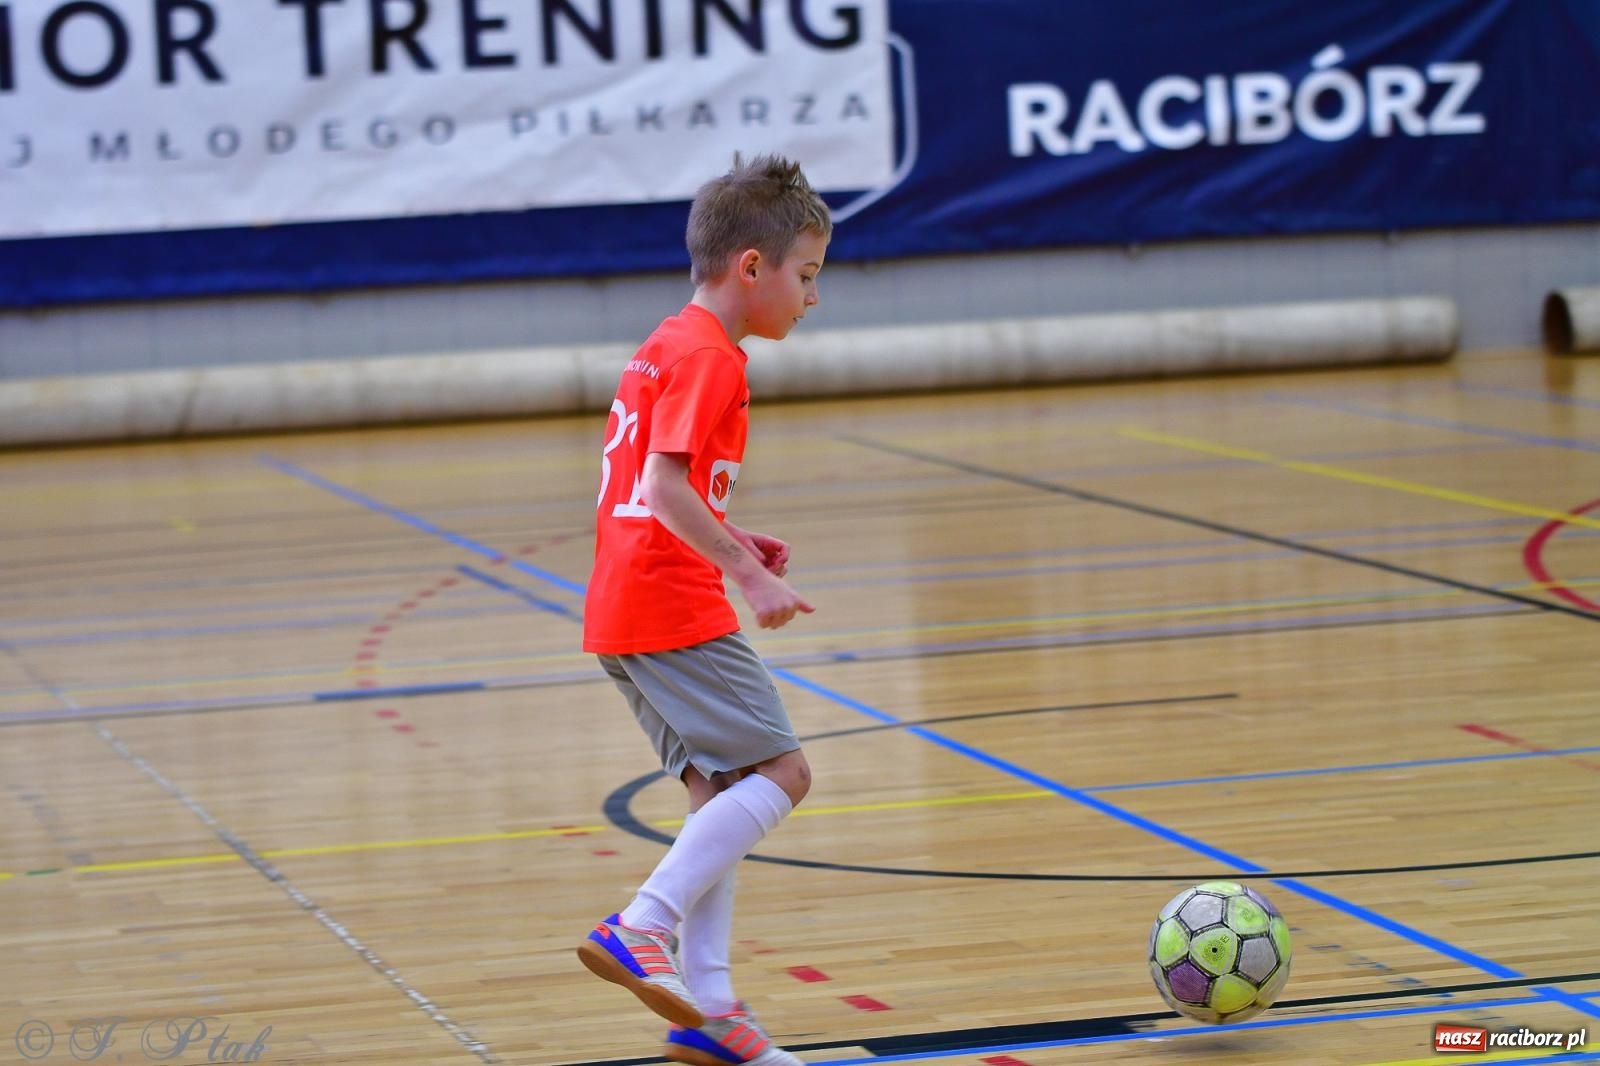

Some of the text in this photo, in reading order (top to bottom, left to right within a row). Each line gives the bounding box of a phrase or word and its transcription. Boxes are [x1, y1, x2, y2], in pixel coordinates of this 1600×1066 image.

[277, 0, 861, 78] TRENING
[510, 94, 868, 138] PIŁKARZA
[1007, 45, 1486, 157] RACIBÓRZ
